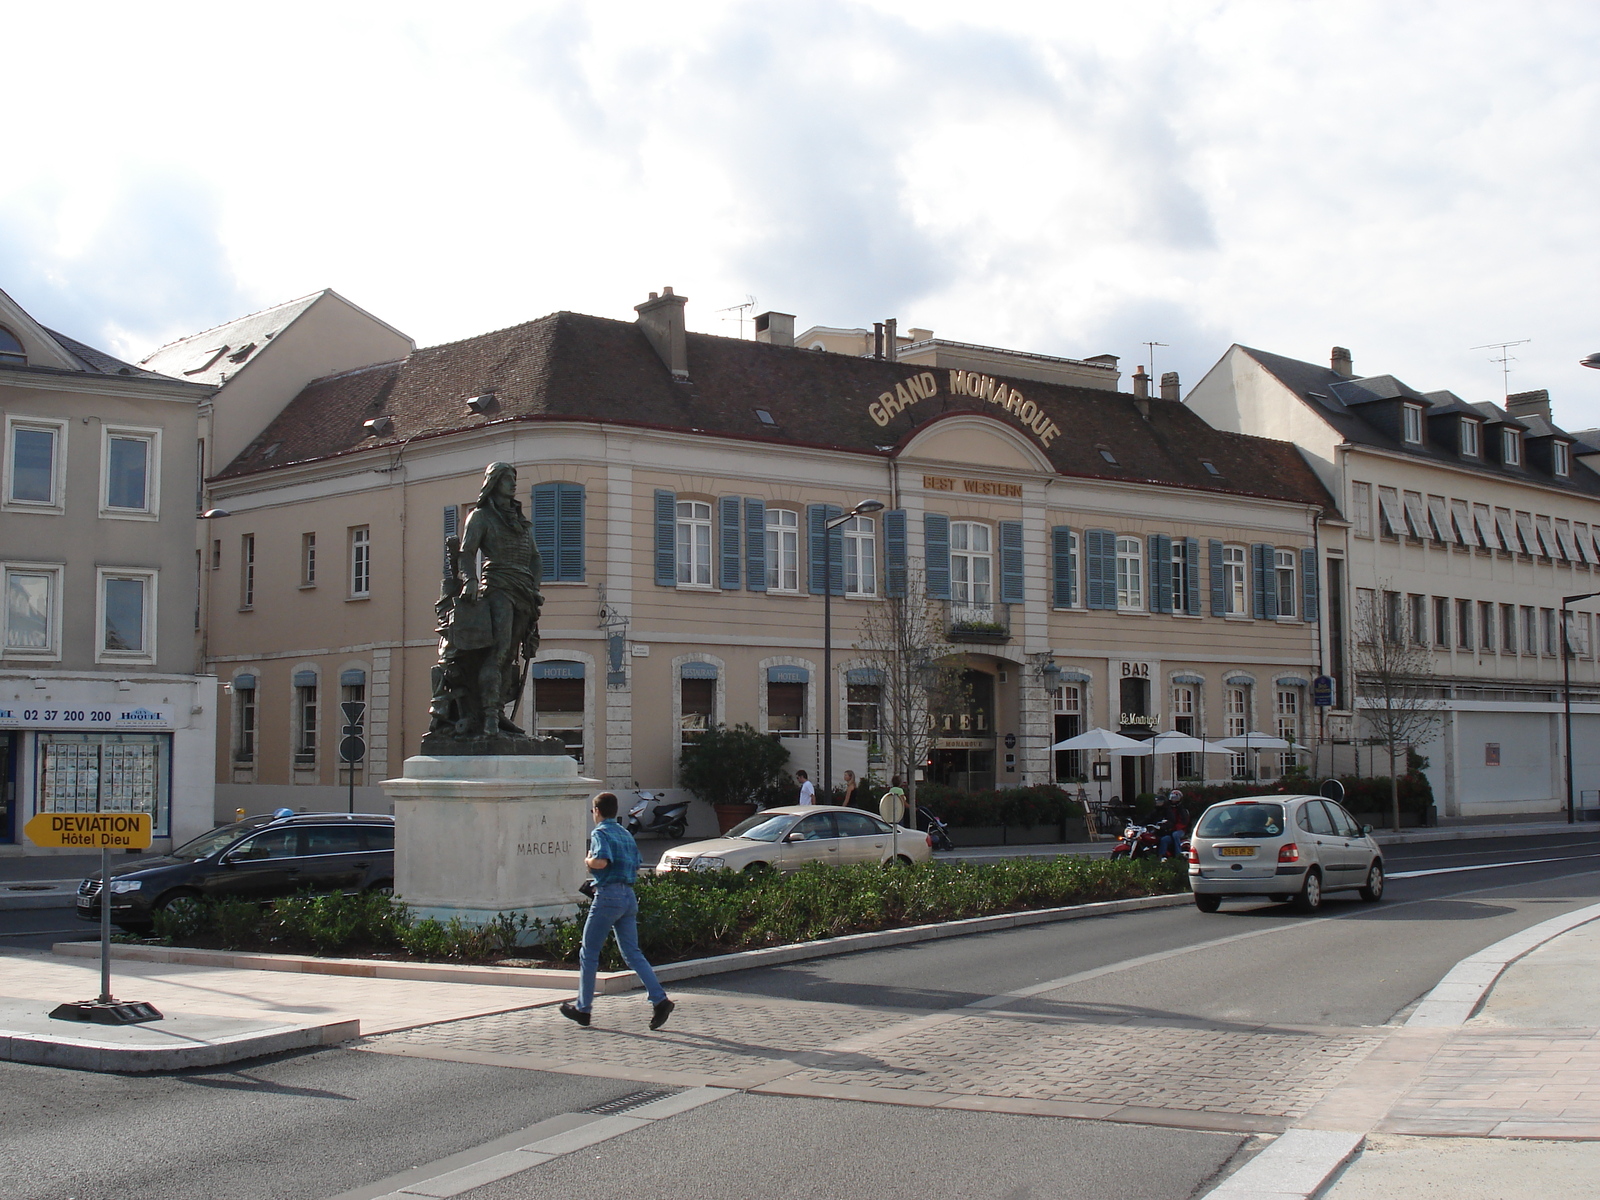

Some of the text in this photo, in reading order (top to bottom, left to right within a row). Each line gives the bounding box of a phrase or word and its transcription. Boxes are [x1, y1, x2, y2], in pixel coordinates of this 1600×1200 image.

[868, 369, 1062, 449] GRAND MONARQUE
[923, 475, 1022, 498] BEST WESTERN
[544, 668, 573, 677] HOTEL
[1122, 662, 1149, 677] BAR
[777, 673, 800, 681] HOTEL
[24, 709, 112, 722] 02 37 200 200
[52, 817, 140, 832] DEVIATION
[541, 815, 547, 825] A
[61, 833, 130, 846] Hôtel Dieu
[517, 840, 569, 857] MARCEAU
